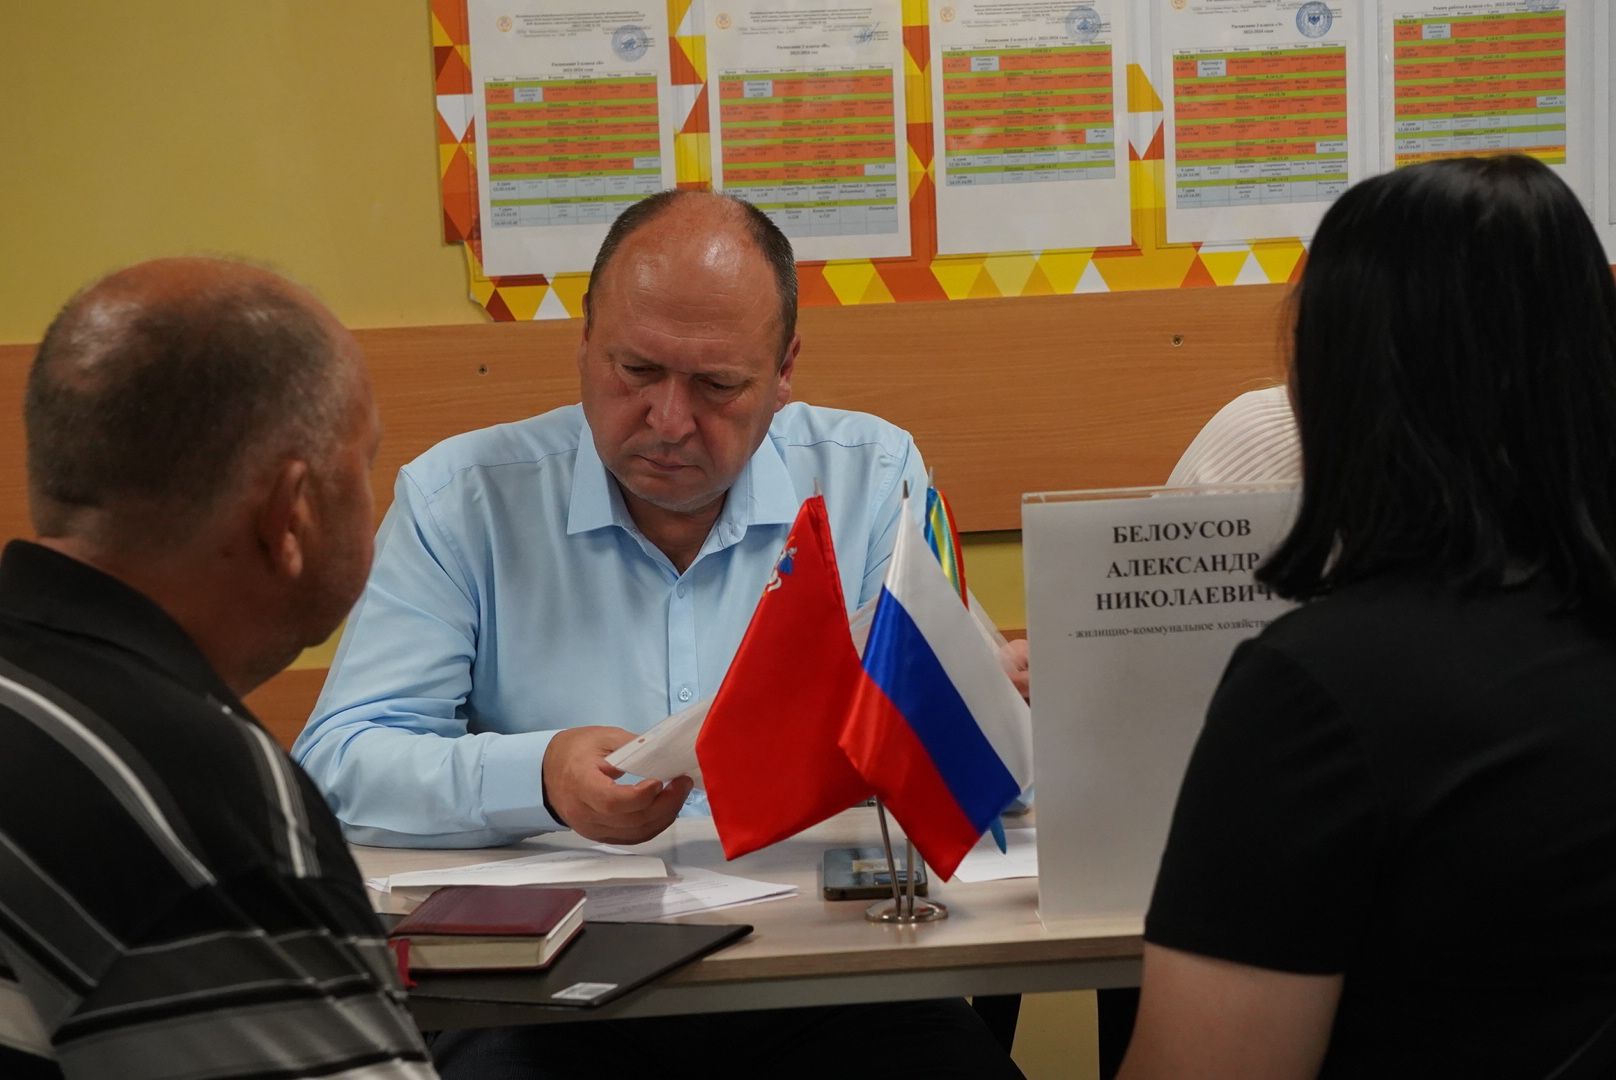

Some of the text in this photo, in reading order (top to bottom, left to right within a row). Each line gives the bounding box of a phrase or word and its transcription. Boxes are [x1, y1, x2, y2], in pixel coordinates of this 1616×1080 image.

[1113, 518, 1252, 544] БЕЛОУСОВ
[1106, 552, 1260, 579] АЛЕКСАНДР
[1096, 584, 1273, 611] НИКОЛАЕВИЧ
[1075, 619, 1214, 639] жилищно-коммунальное
